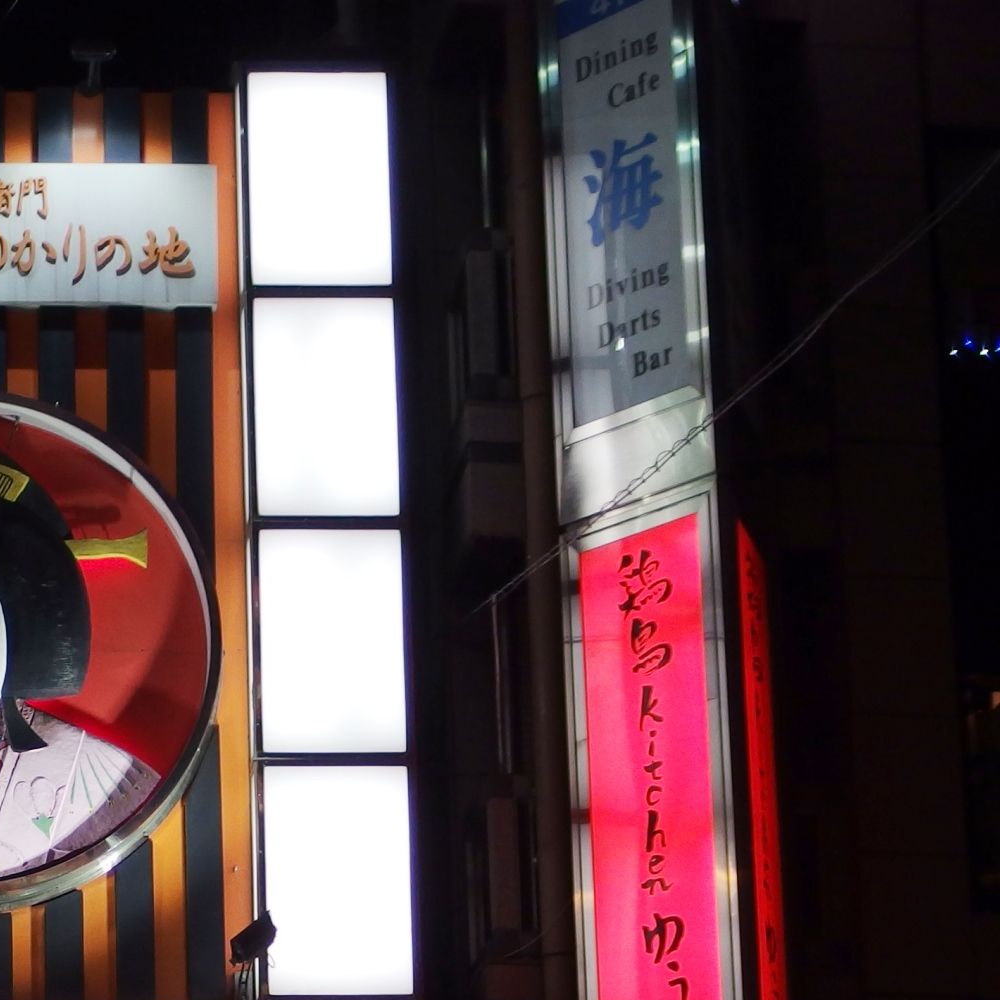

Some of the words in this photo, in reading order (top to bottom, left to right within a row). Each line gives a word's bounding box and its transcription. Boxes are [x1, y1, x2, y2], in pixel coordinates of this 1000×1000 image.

[575, 32, 658, 83] Dining
[608, 72, 660, 108] Cafe
[583, 132, 663, 248] 海
[587, 261, 670, 311] Diving
[598, 307, 662, 350] Darts
[633, 346, 673, 379] Bar
